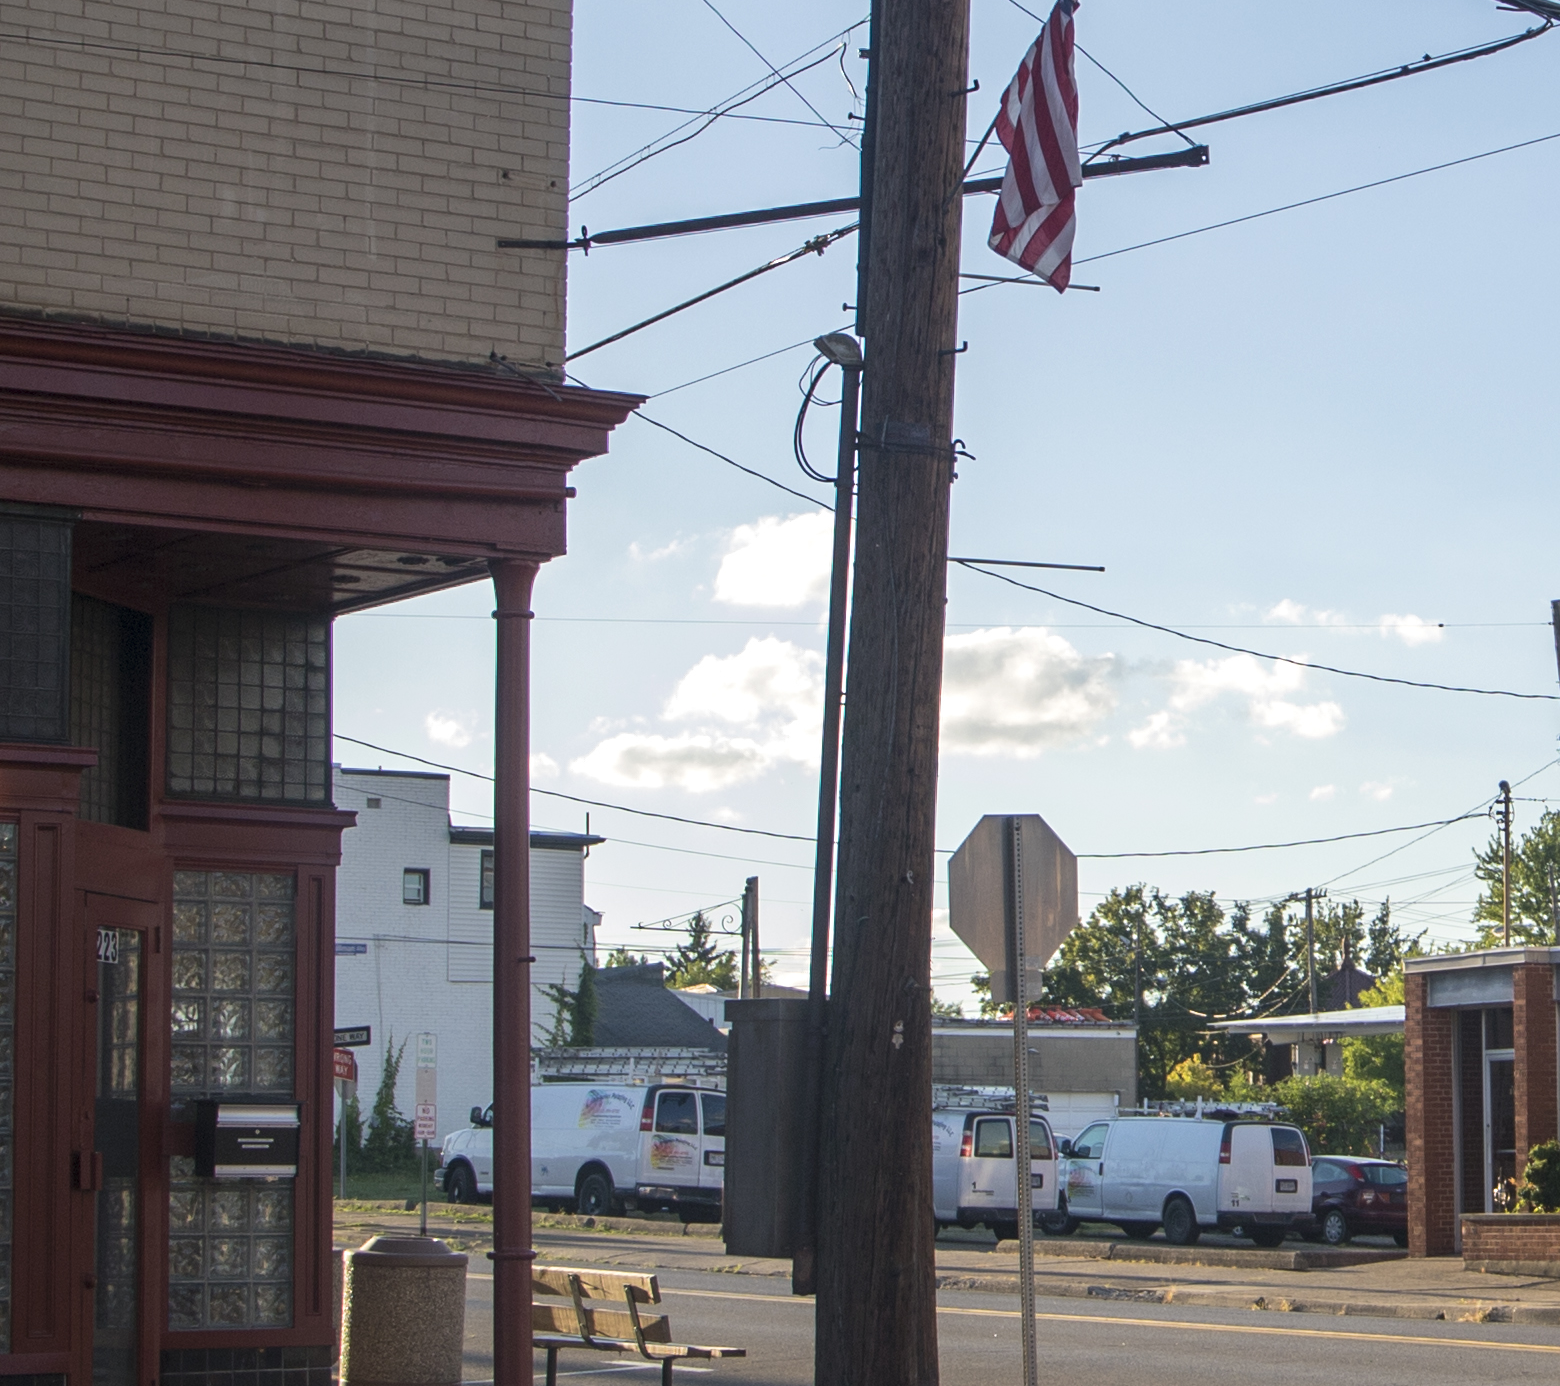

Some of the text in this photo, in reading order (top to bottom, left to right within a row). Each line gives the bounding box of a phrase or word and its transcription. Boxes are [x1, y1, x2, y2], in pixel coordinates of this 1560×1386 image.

[96, 931, 118, 962] 223
[349, 1032, 364, 1040] WAY
[334, 1051, 352, 1066] RONG
[335, 1064, 349, 1076] WAY
[1231, 1199, 1240, 1207] 11
